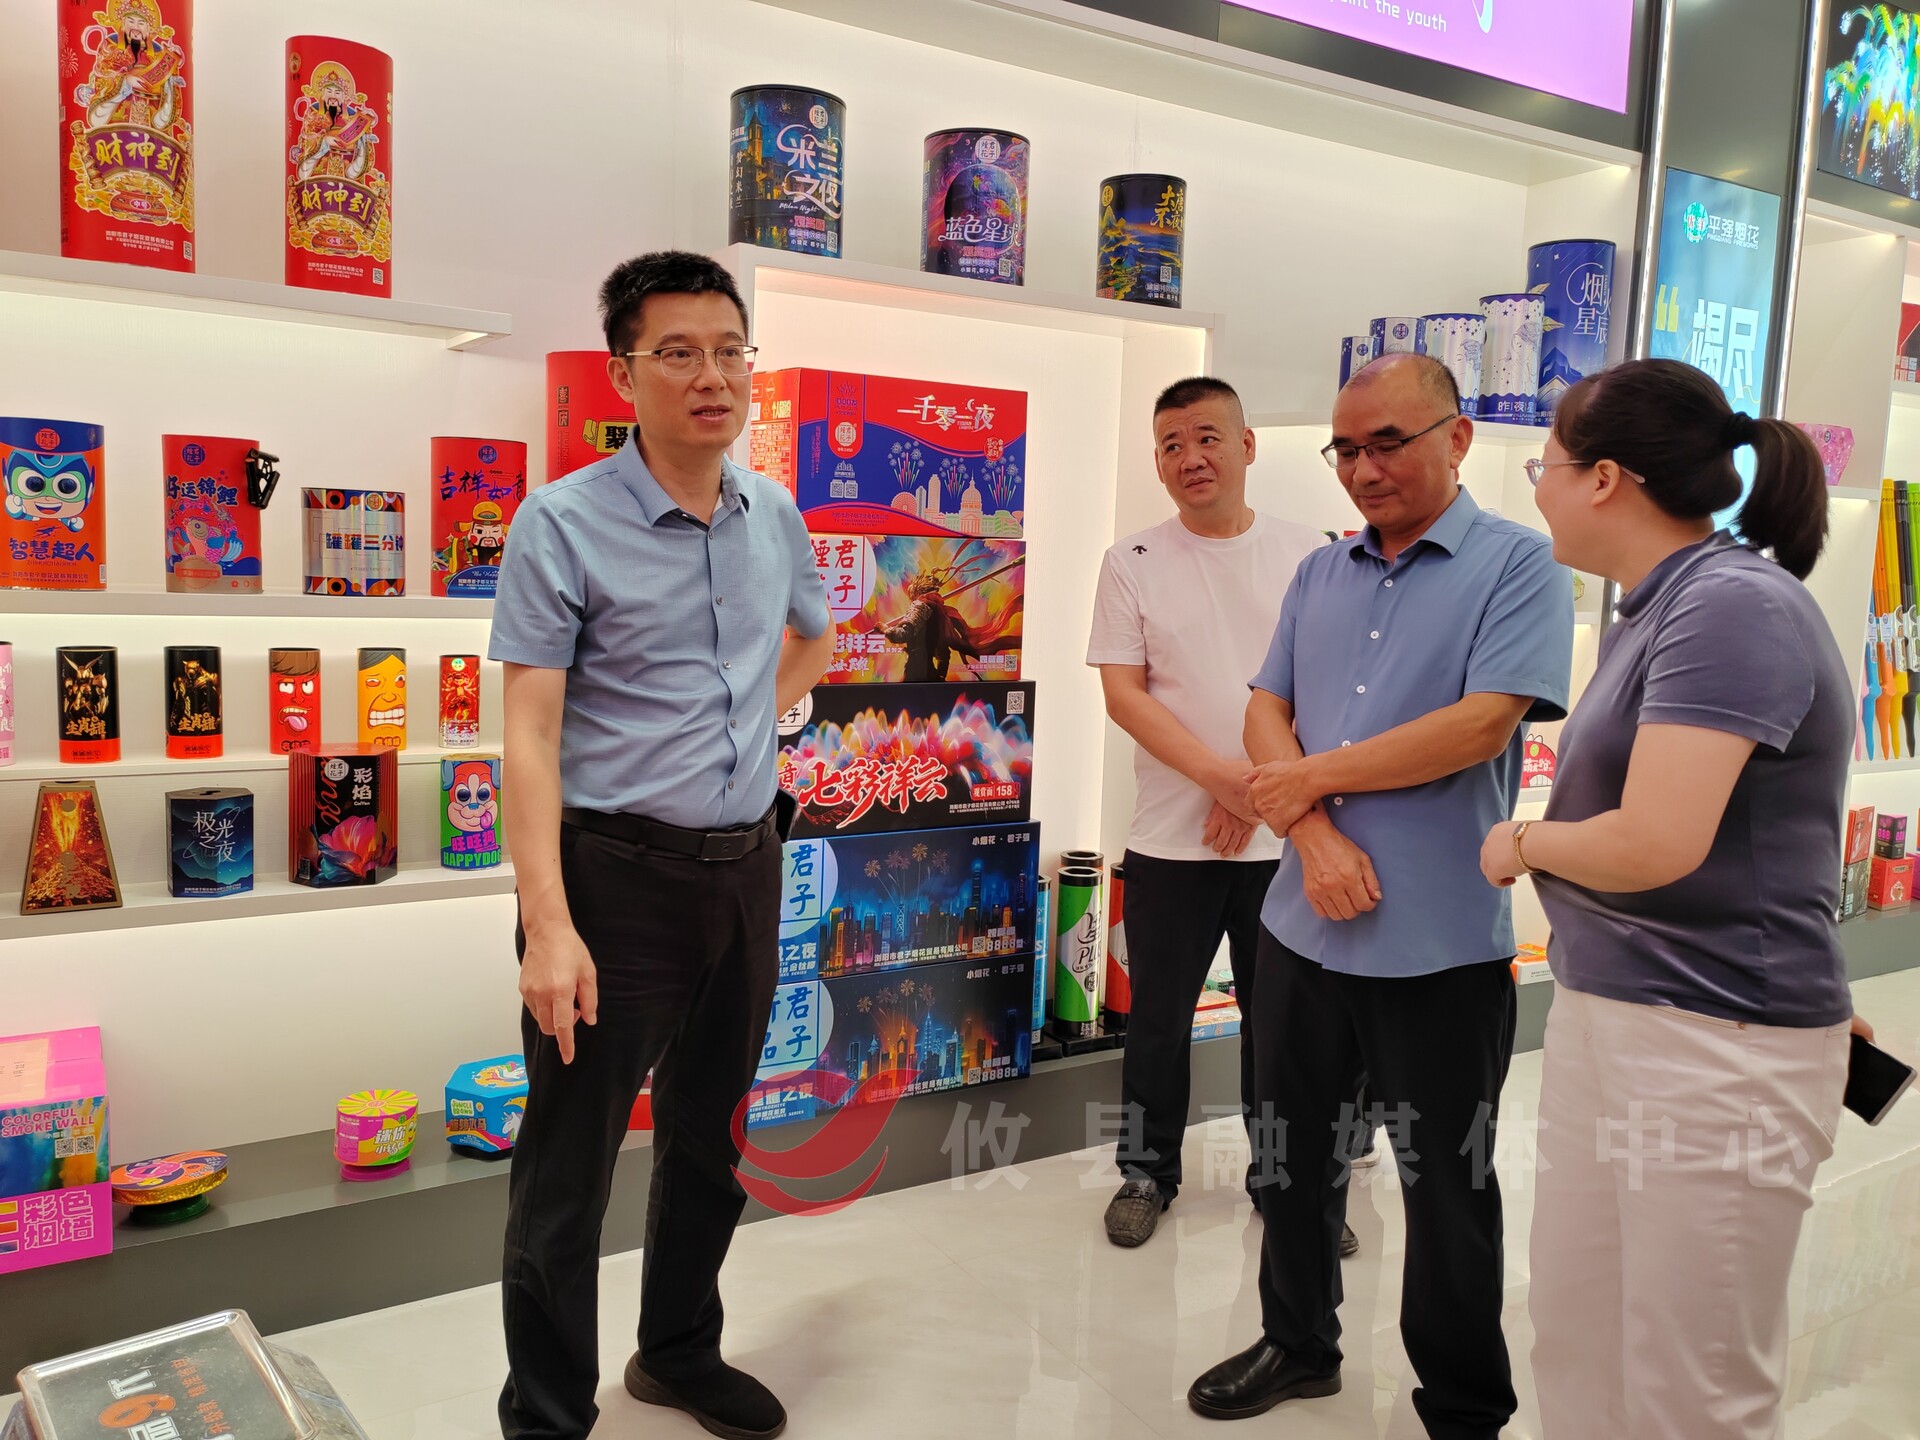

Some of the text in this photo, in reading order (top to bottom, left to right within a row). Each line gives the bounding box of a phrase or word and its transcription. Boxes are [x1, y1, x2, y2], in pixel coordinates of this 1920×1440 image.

[1375, 0, 1400, 18] the
[1406, 9, 1447, 32] youth
[95, 132, 181, 182] 财神到
[778, 126, 842, 172] 米兰
[302, 181, 372, 221] 财神到
[779, 201, 820, 214] Milan Night
[1155, 185, 1184, 212] 大唐
[938, 214, 1021, 247] 蓝色星球
[1706, 233, 1759, 250] PINGQIANG FIREWORKS
[1708, 214, 1760, 244] 平强烟花
[1573, 307, 1609, 344] 星辰
[897, 394, 996, 432] 一千零一夜
[166, 475, 239, 506] 好运锦鲤
[439, 466, 527, 502] 吉祥如意
[9, 537, 95, 562] 智慧超人
[65, 716, 106, 737] 生肖罐
[178, 712, 216, 732] 生肖罐
[352, 767, 373, 800] 彩焰
[798, 754, 948, 829] 七彩祥云
[974, 785, 1013, 797] 观赏面 158
[192, 811, 235, 841] 极光
[452, 829, 496, 852] 旺旺狗
[972, 835, 997, 846] 小烟花
[199, 833, 236, 863] 之夜
[874, 944, 968, 963] 浏阳市君子烟花贸易有限公司
[966, 968, 990, 979] 小烟花
[2, 1108, 76, 1127] COLORFUL
[2, 1116, 95, 1138] SMOKE WALL
[375, 1126, 407, 1145] 迷你
[24, 1190, 93, 1224] 彩色
[24, 1215, 94, 1250] 烟墙
